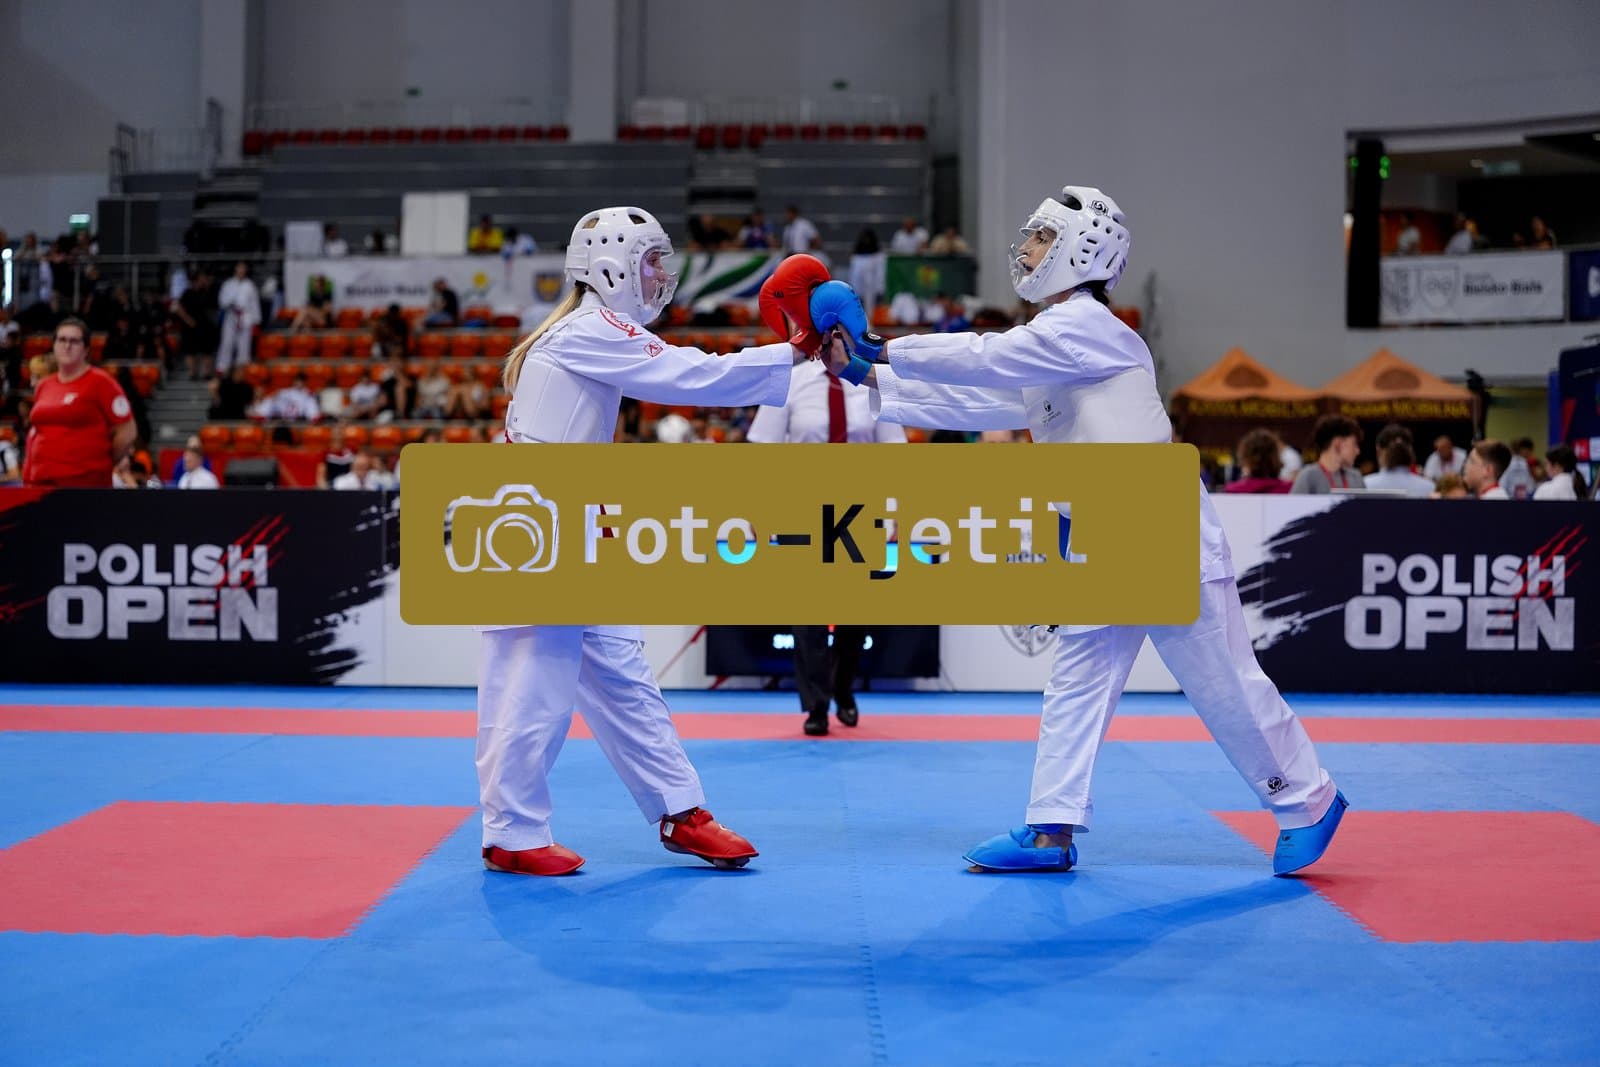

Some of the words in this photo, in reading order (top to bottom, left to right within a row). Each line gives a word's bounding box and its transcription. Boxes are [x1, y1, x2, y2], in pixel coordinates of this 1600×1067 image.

[64, 543, 268, 586] POLISH
[1362, 553, 1565, 596] POLISH
[47, 585, 278, 641] OPEN
[1344, 595, 1575, 650] OPEN
